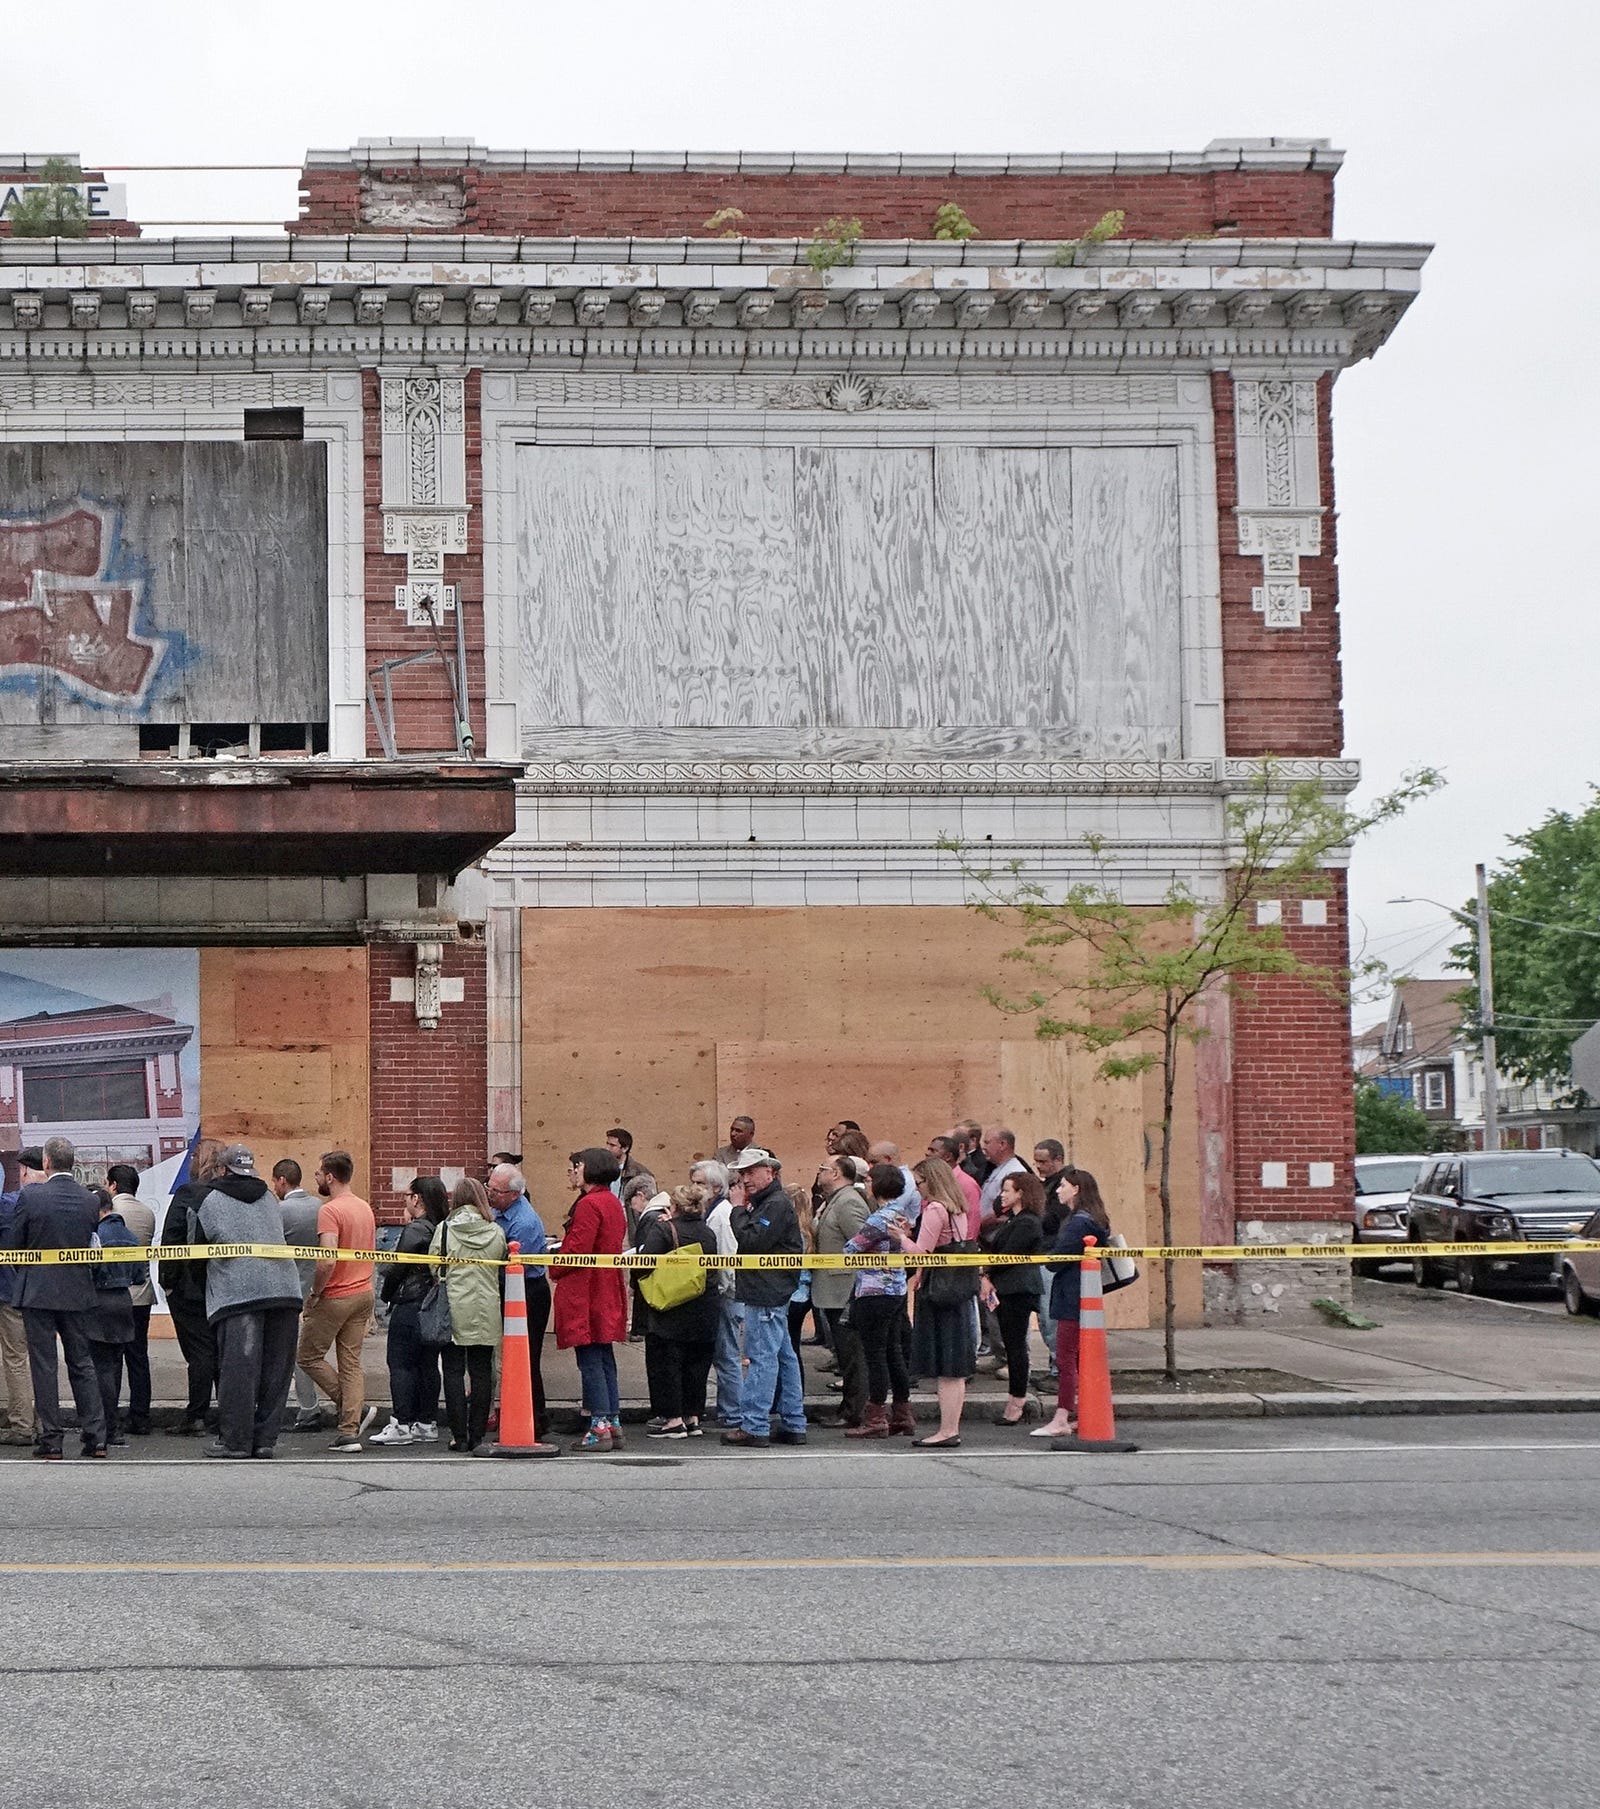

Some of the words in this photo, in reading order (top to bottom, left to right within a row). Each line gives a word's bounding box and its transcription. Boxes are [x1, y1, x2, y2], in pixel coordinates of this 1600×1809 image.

[58, 1250, 103, 1262] CAUTION
[146, 1247, 191, 1259] CAUTION
[207, 1245, 252, 1257] CAUTION
[294, 1248, 338, 1259] CAUTION
[1243, 1247, 1286, 1257] CAUTION
[1302, 1246, 1345, 1257] CAUTION
[552, 1255, 597, 1266] CAUTION
[613, 1255, 657, 1266] CAUTION
[698, 1256, 743, 1267] CAUTION
[759, 1256, 803, 1267] CAUTION
[844, 1255, 888, 1267] CAUTION
[903, 1255, 948, 1266] CAUTION
